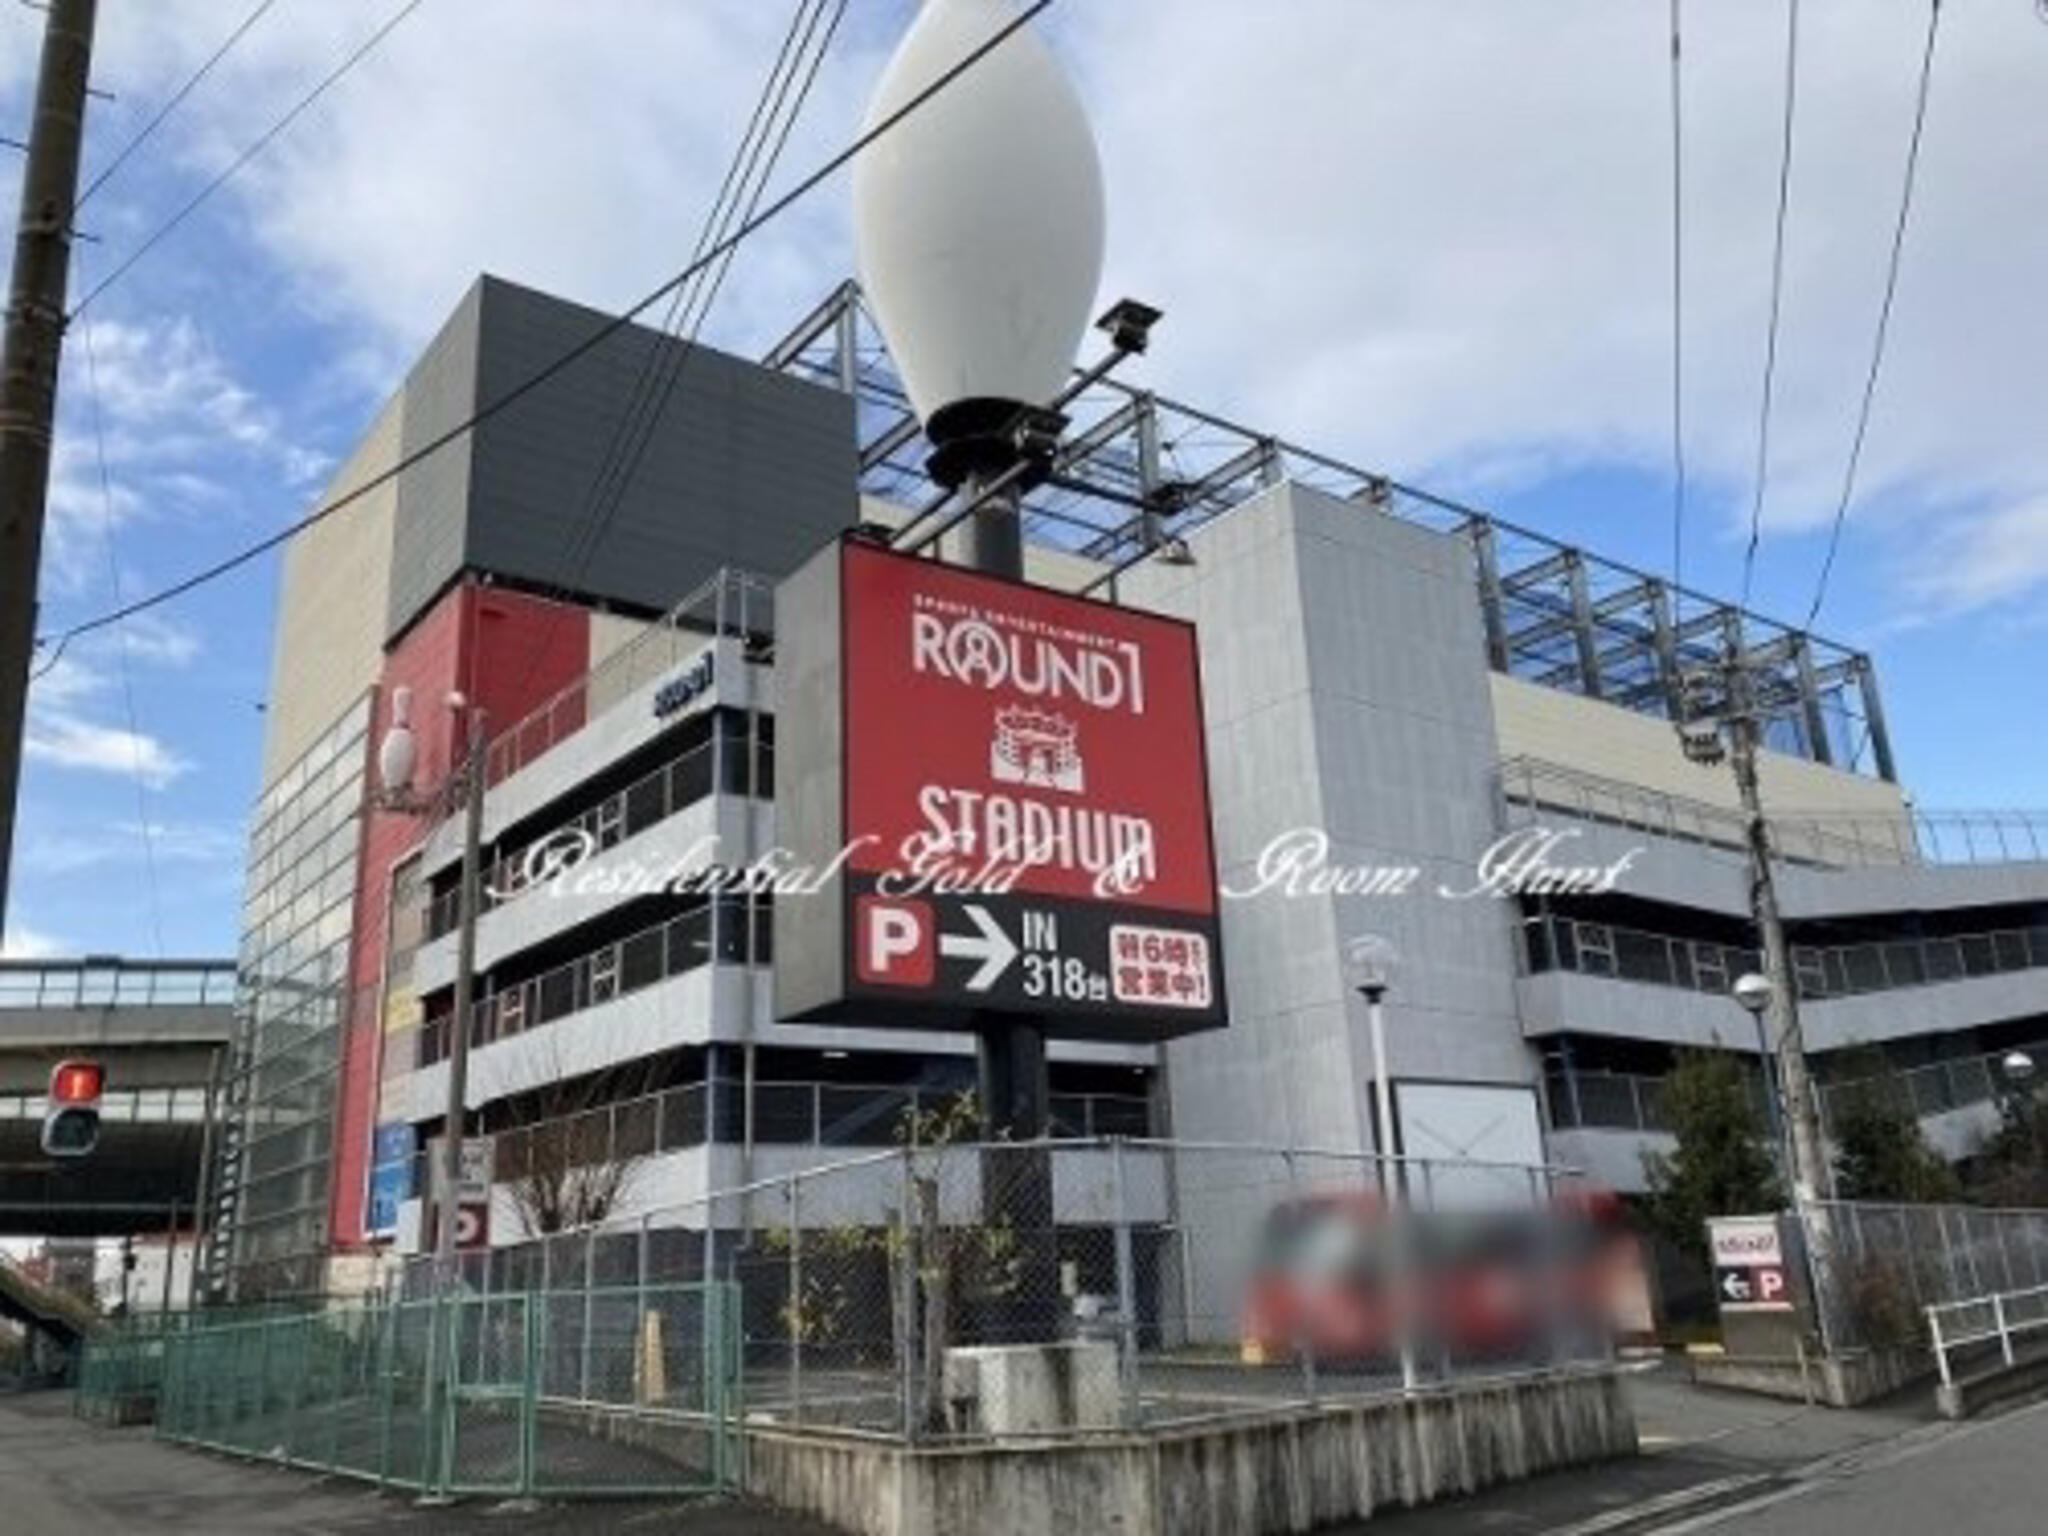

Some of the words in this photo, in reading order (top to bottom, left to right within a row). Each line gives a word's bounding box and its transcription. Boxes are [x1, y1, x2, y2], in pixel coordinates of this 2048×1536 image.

[912, 612, 1145, 714] ROUND1
[918, 785, 1156, 881] STADIUM
[869, 907, 921, 972] P
[1022, 911, 1057, 952] IN
[1760, 1270, 1783, 1299] P
